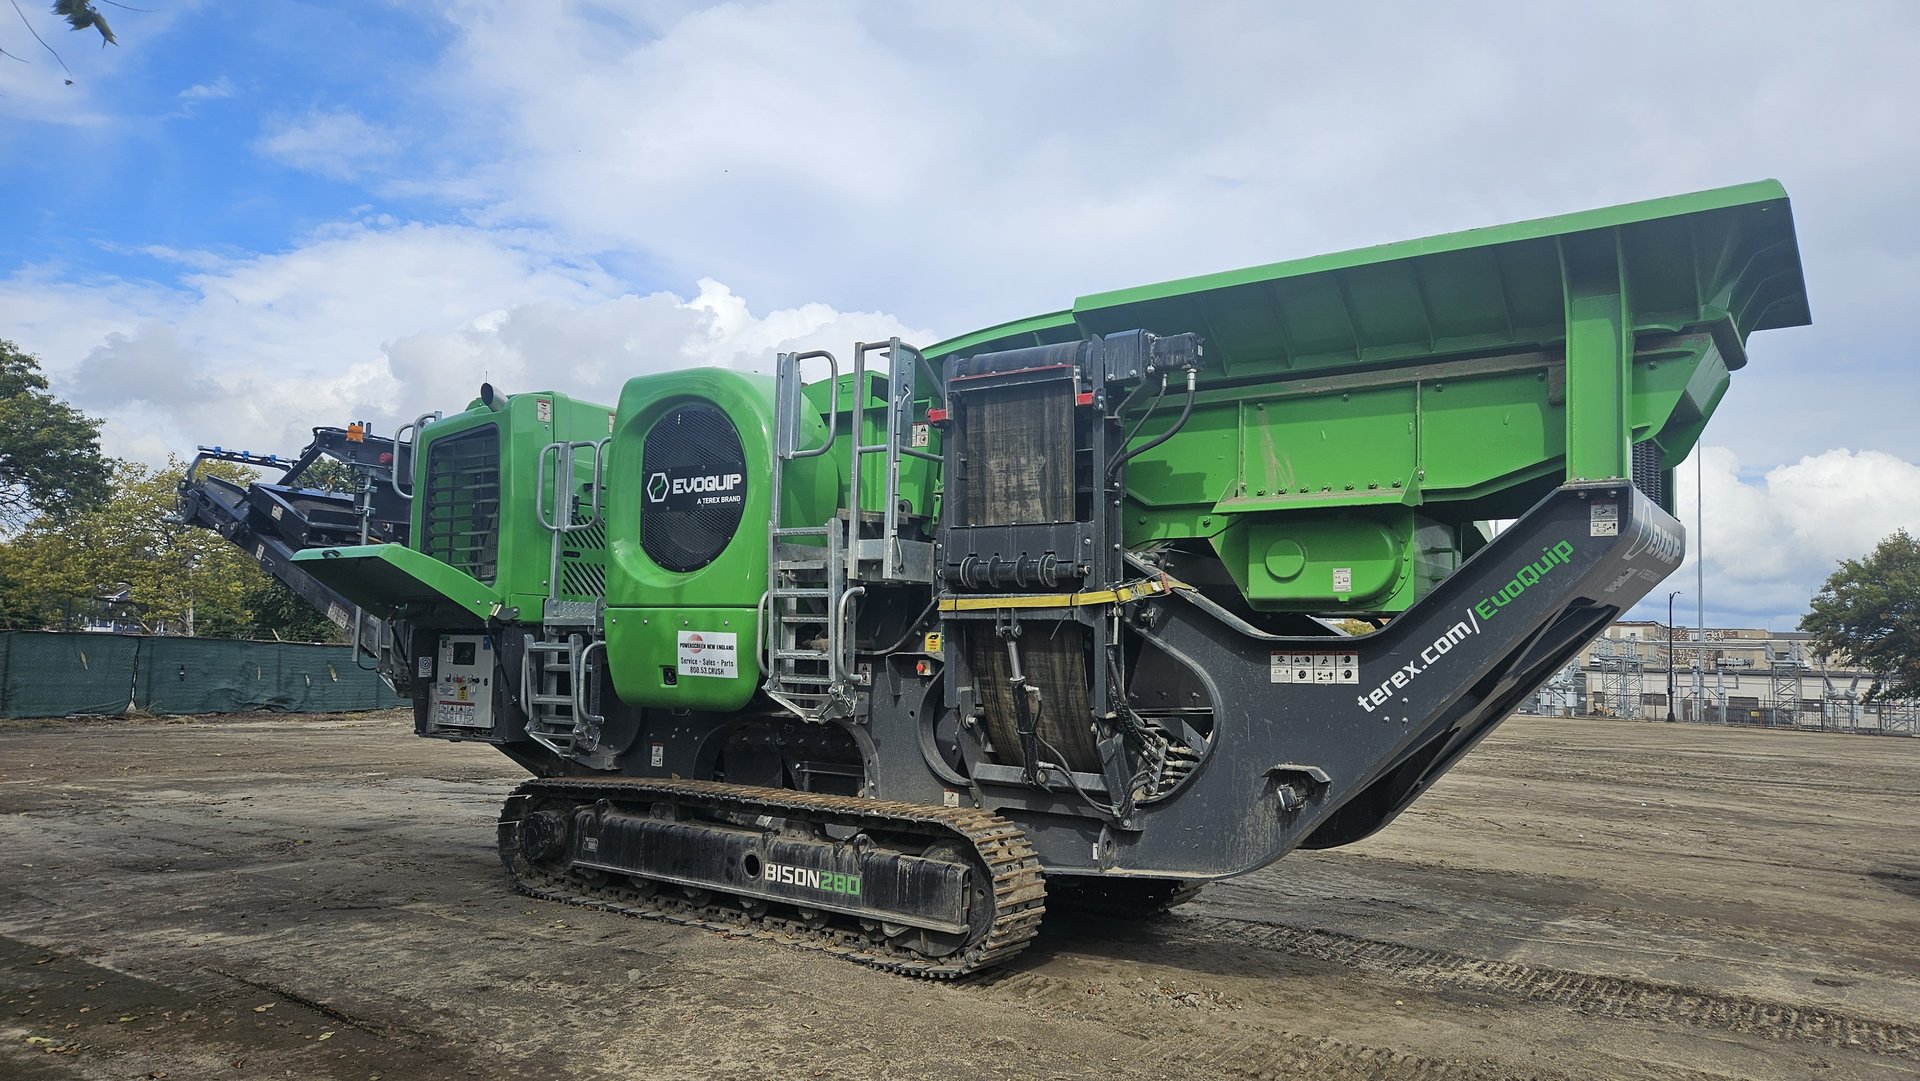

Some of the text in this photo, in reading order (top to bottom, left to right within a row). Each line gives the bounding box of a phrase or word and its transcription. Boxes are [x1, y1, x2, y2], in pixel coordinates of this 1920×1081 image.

[673, 474, 742, 494] EVOQUIP
[680, 642, 706, 650] POWERSCREEN
[681, 657, 697, 665] Service
[702, 658, 716, 666] Sales
[721, 659, 734, 667] Parts
[690, 666, 725, 676] 800.53.CRUSH
